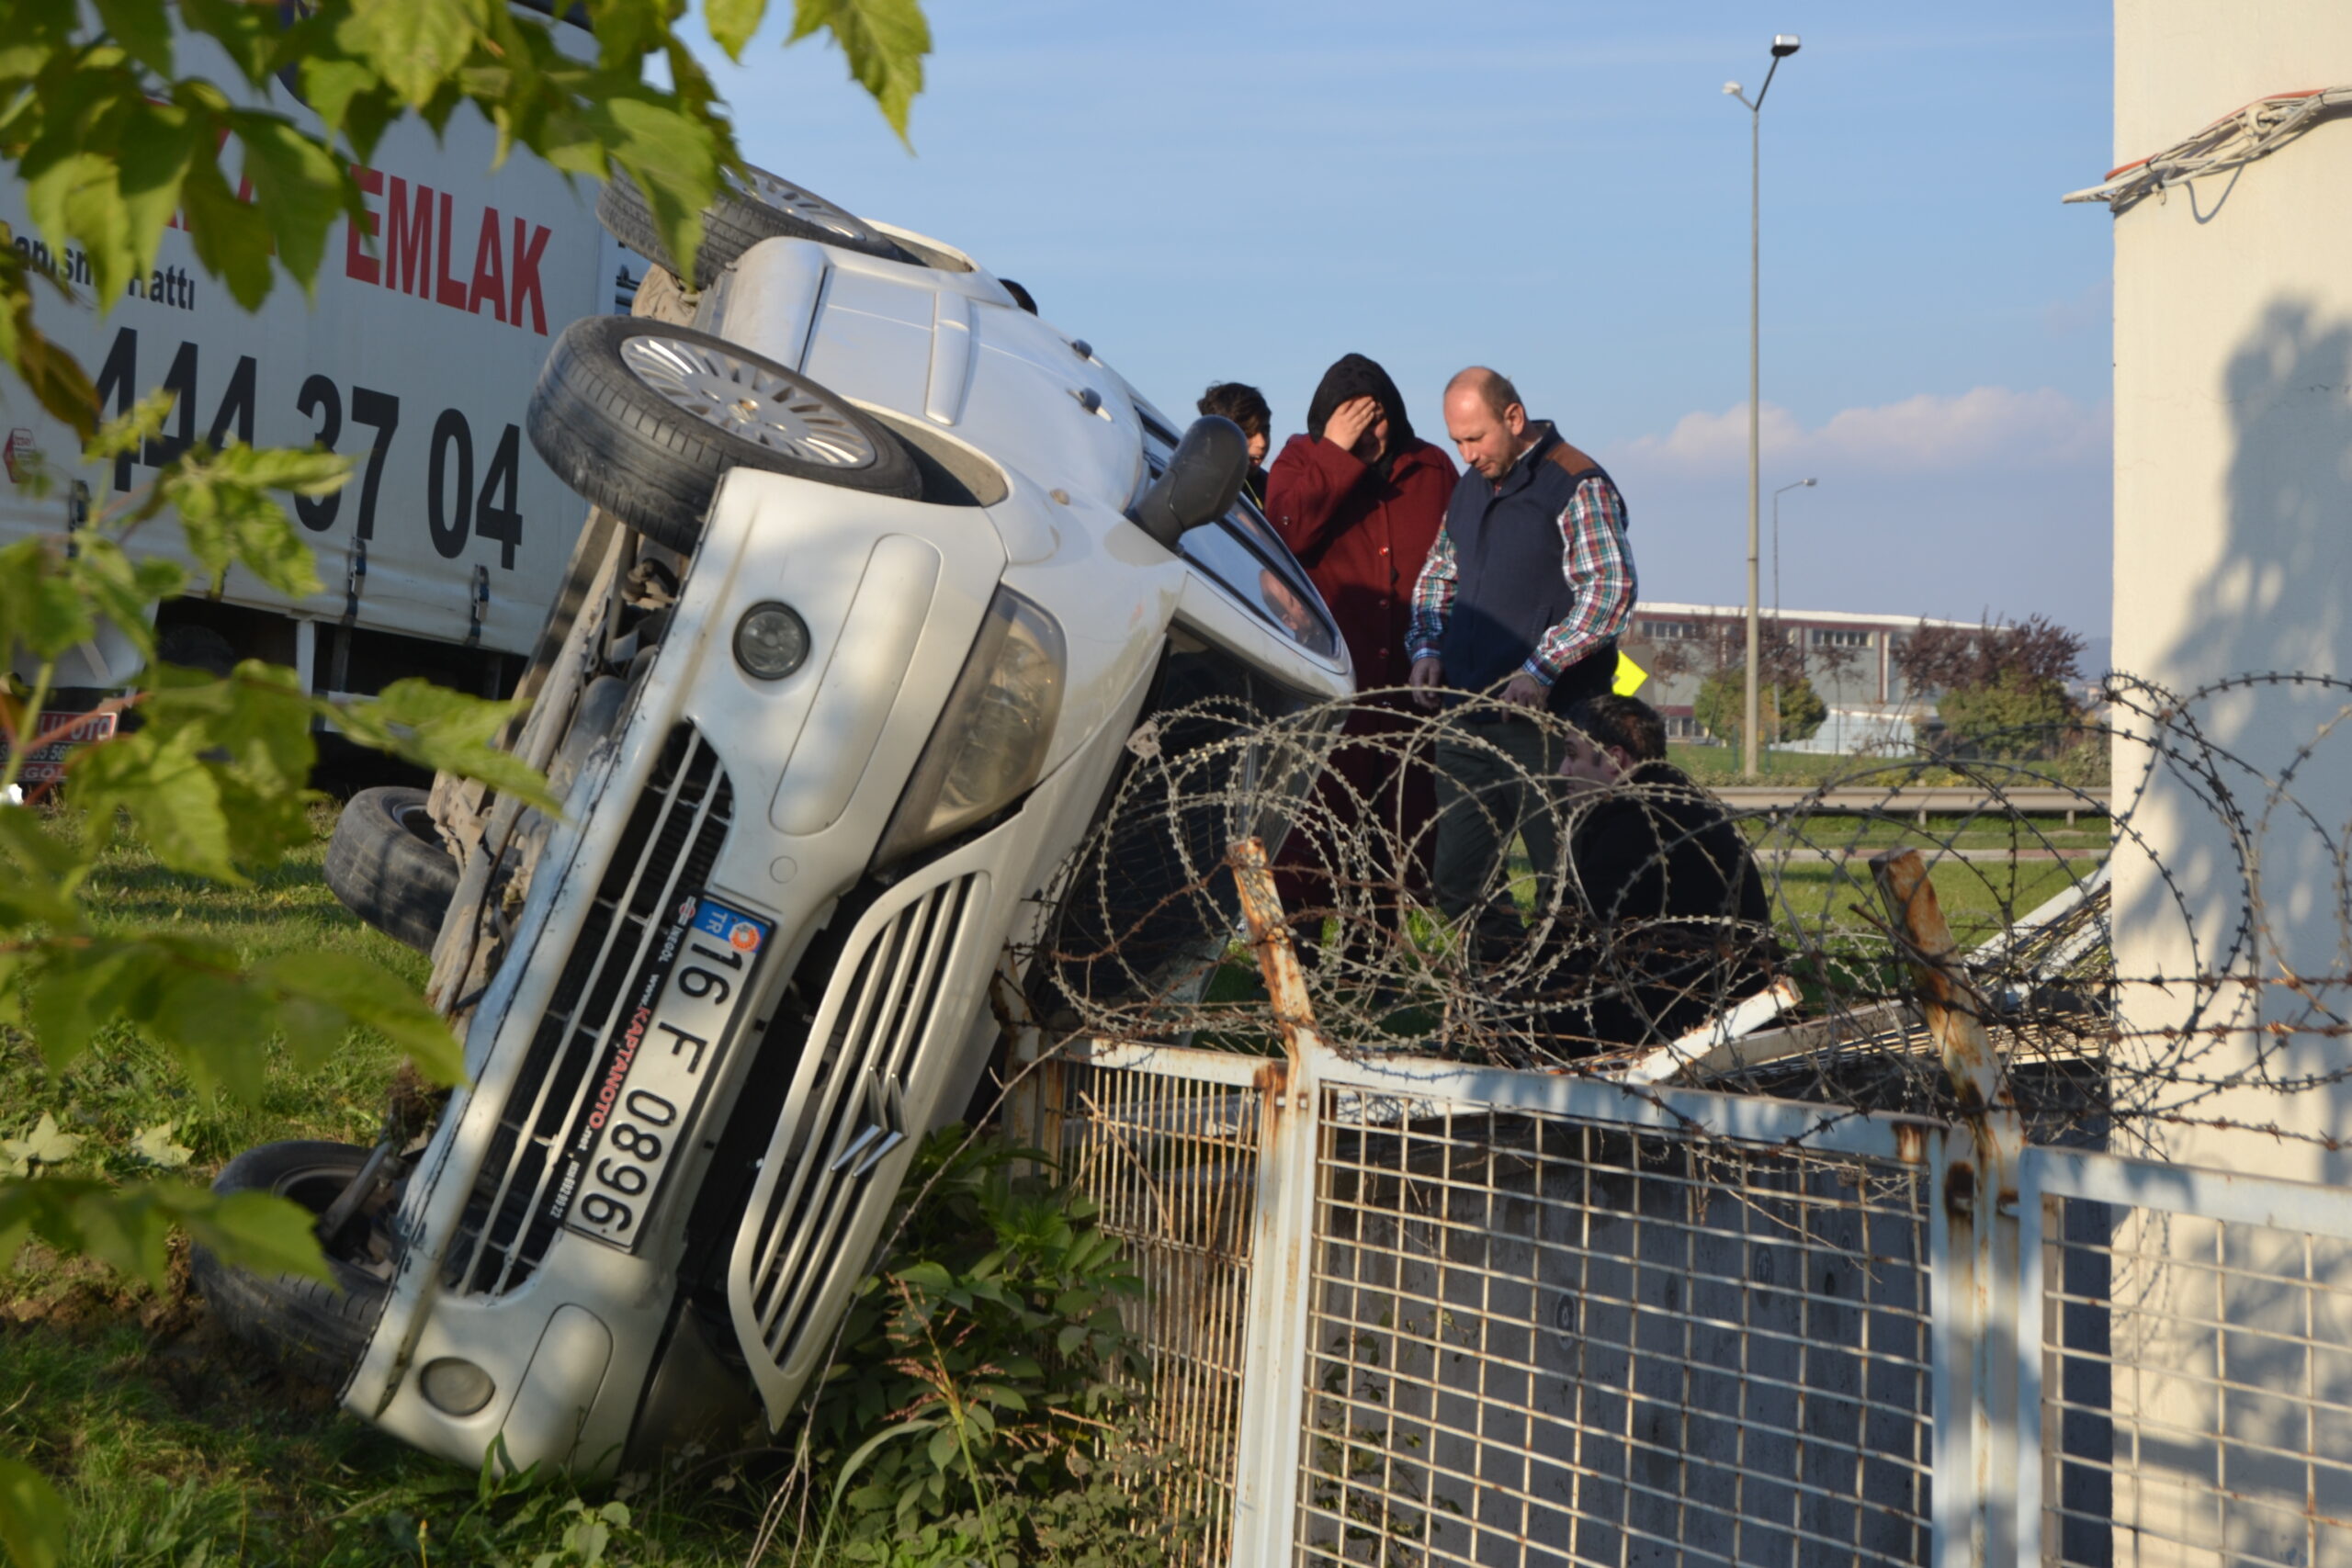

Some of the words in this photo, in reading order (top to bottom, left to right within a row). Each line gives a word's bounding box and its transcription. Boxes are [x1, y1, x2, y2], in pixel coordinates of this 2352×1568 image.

[345, 164, 551, 336] EMLAK
[81, 326, 258, 501] 444
[294, 374, 400, 540] 37
[427, 407, 523, 570] 04
[678, 942, 743, 1006] 16
[706, 910, 729, 935] TR
[658, 1021, 708, 1074] F
[581, 1089, 677, 1233] 0896
